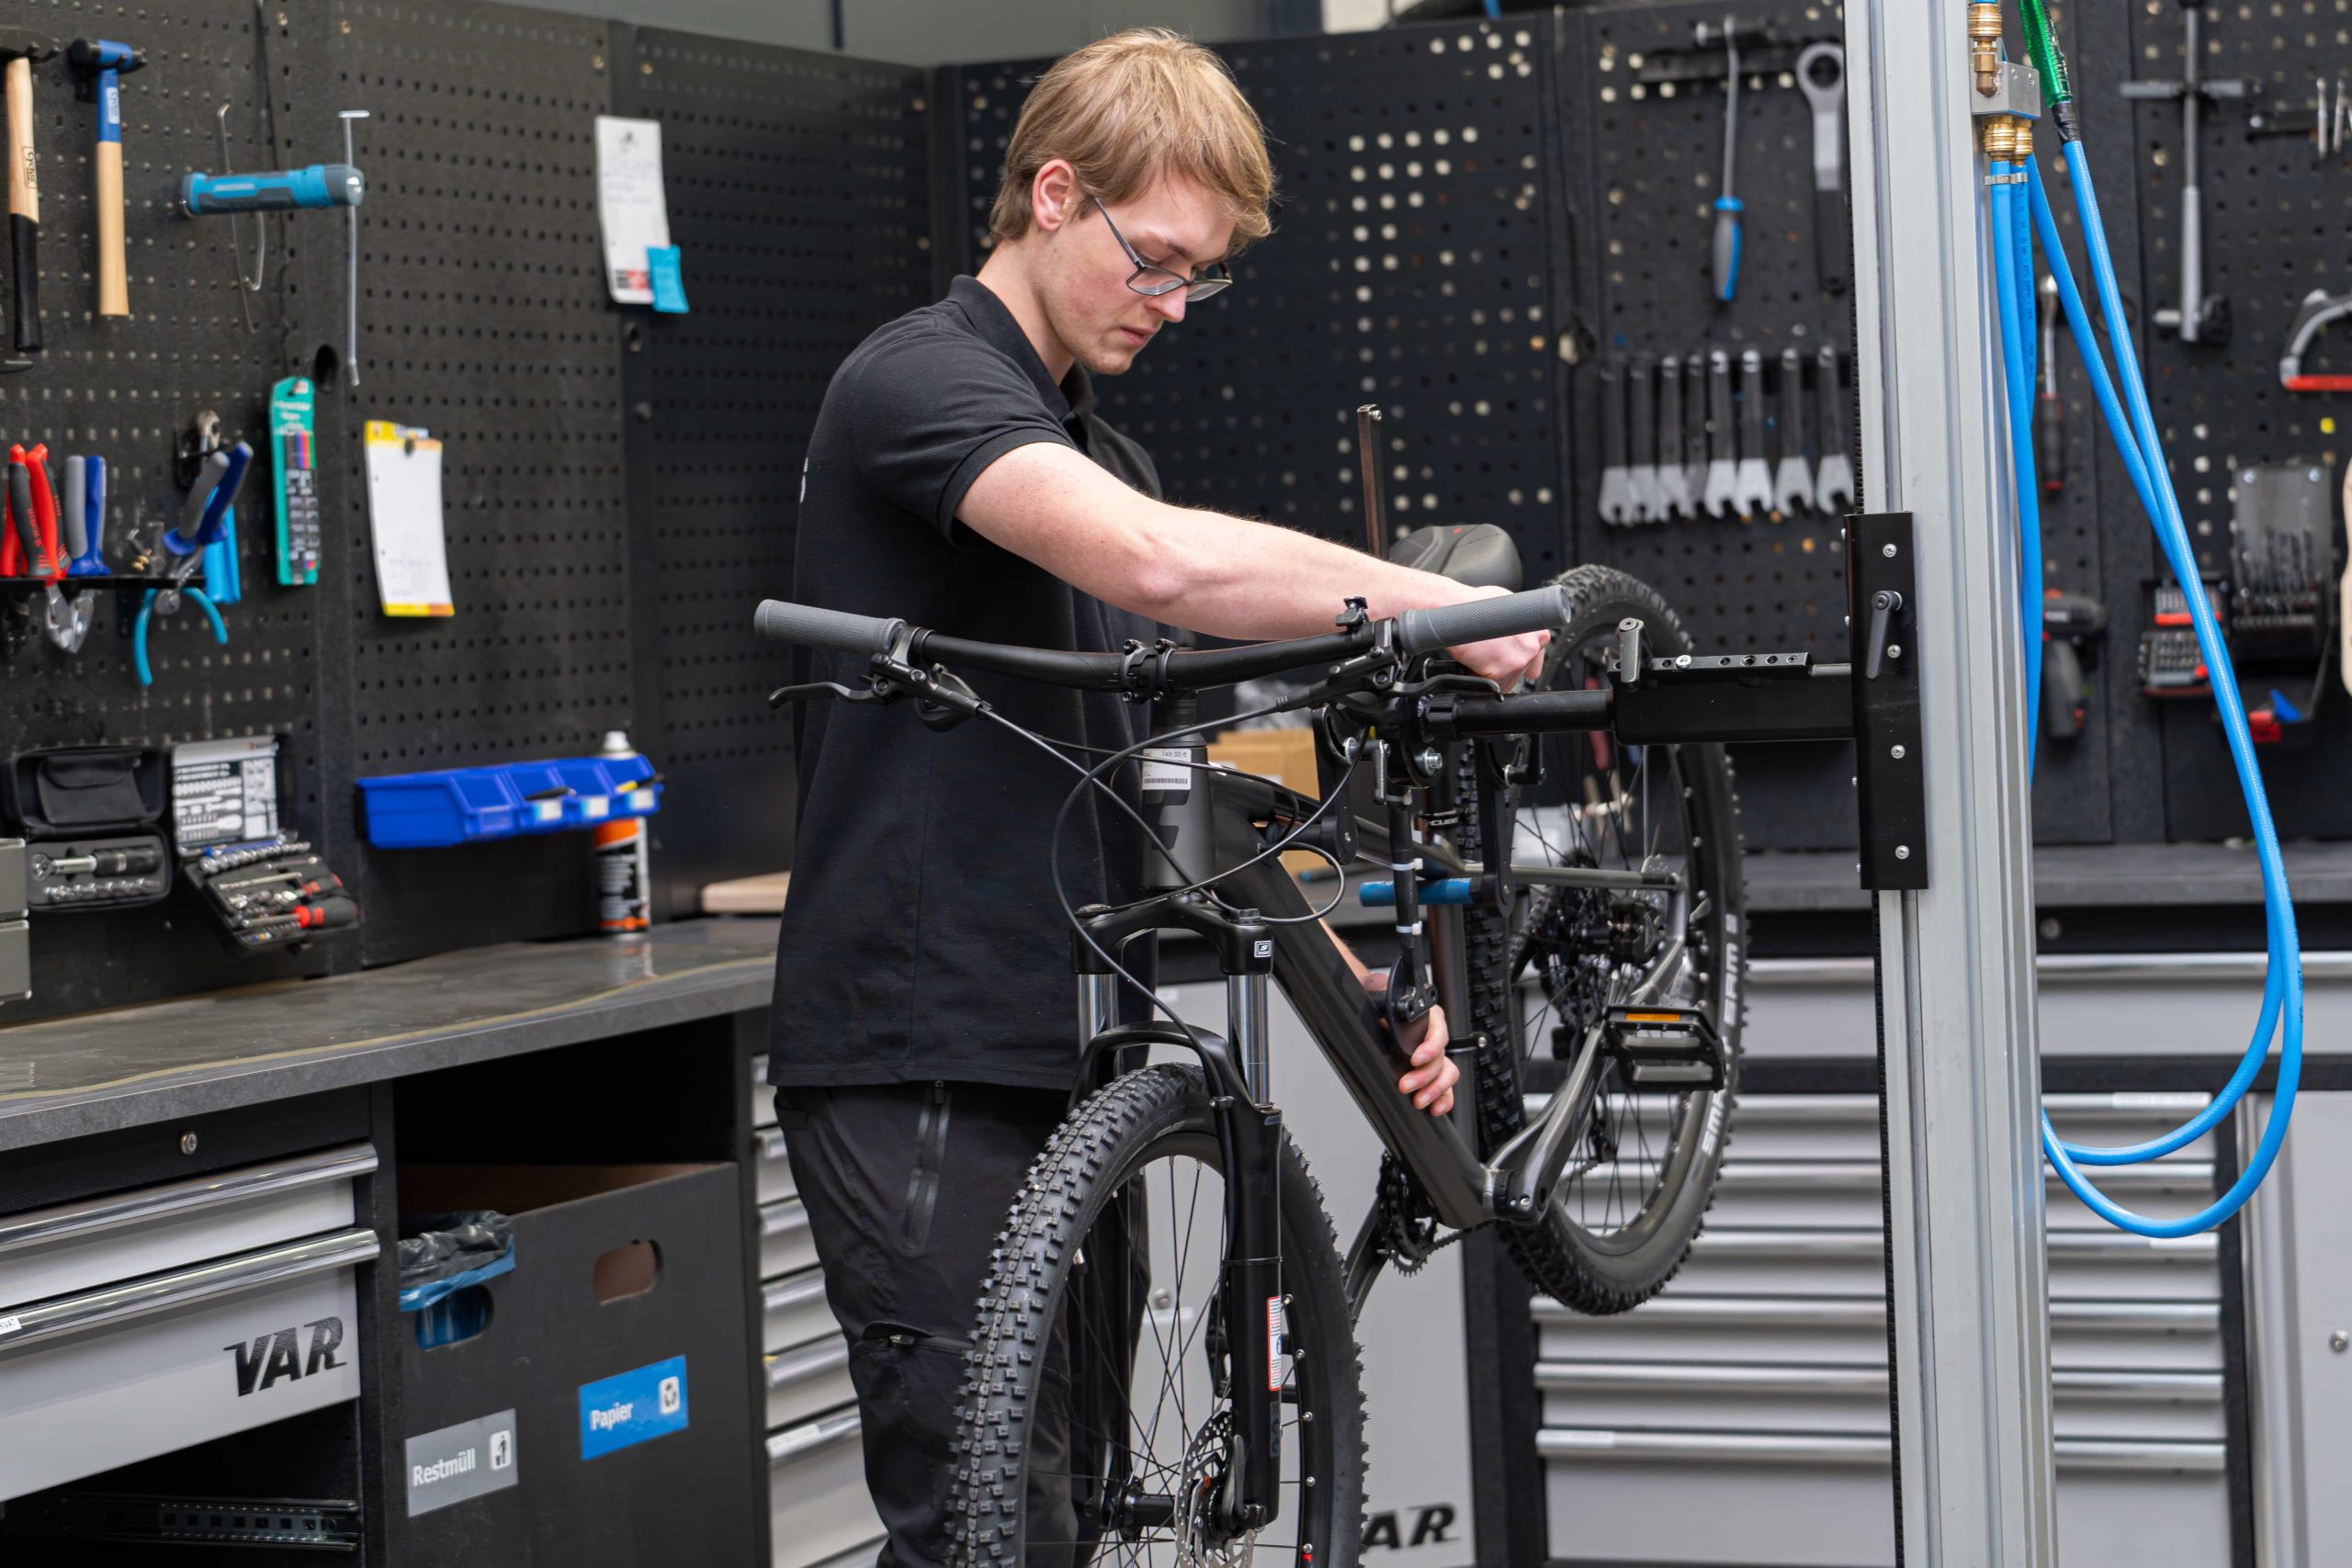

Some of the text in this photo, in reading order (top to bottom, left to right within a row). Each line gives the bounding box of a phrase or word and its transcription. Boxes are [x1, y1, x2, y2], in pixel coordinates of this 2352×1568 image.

[1723, 942, 1739, 1027] SAM
[222, 1314, 348, 1397] VAR
[589, 1401, 634, 1431] Papier
[412, 1448, 477, 1487] Restmüll
[1362, 1501, 1463, 1551] AR
